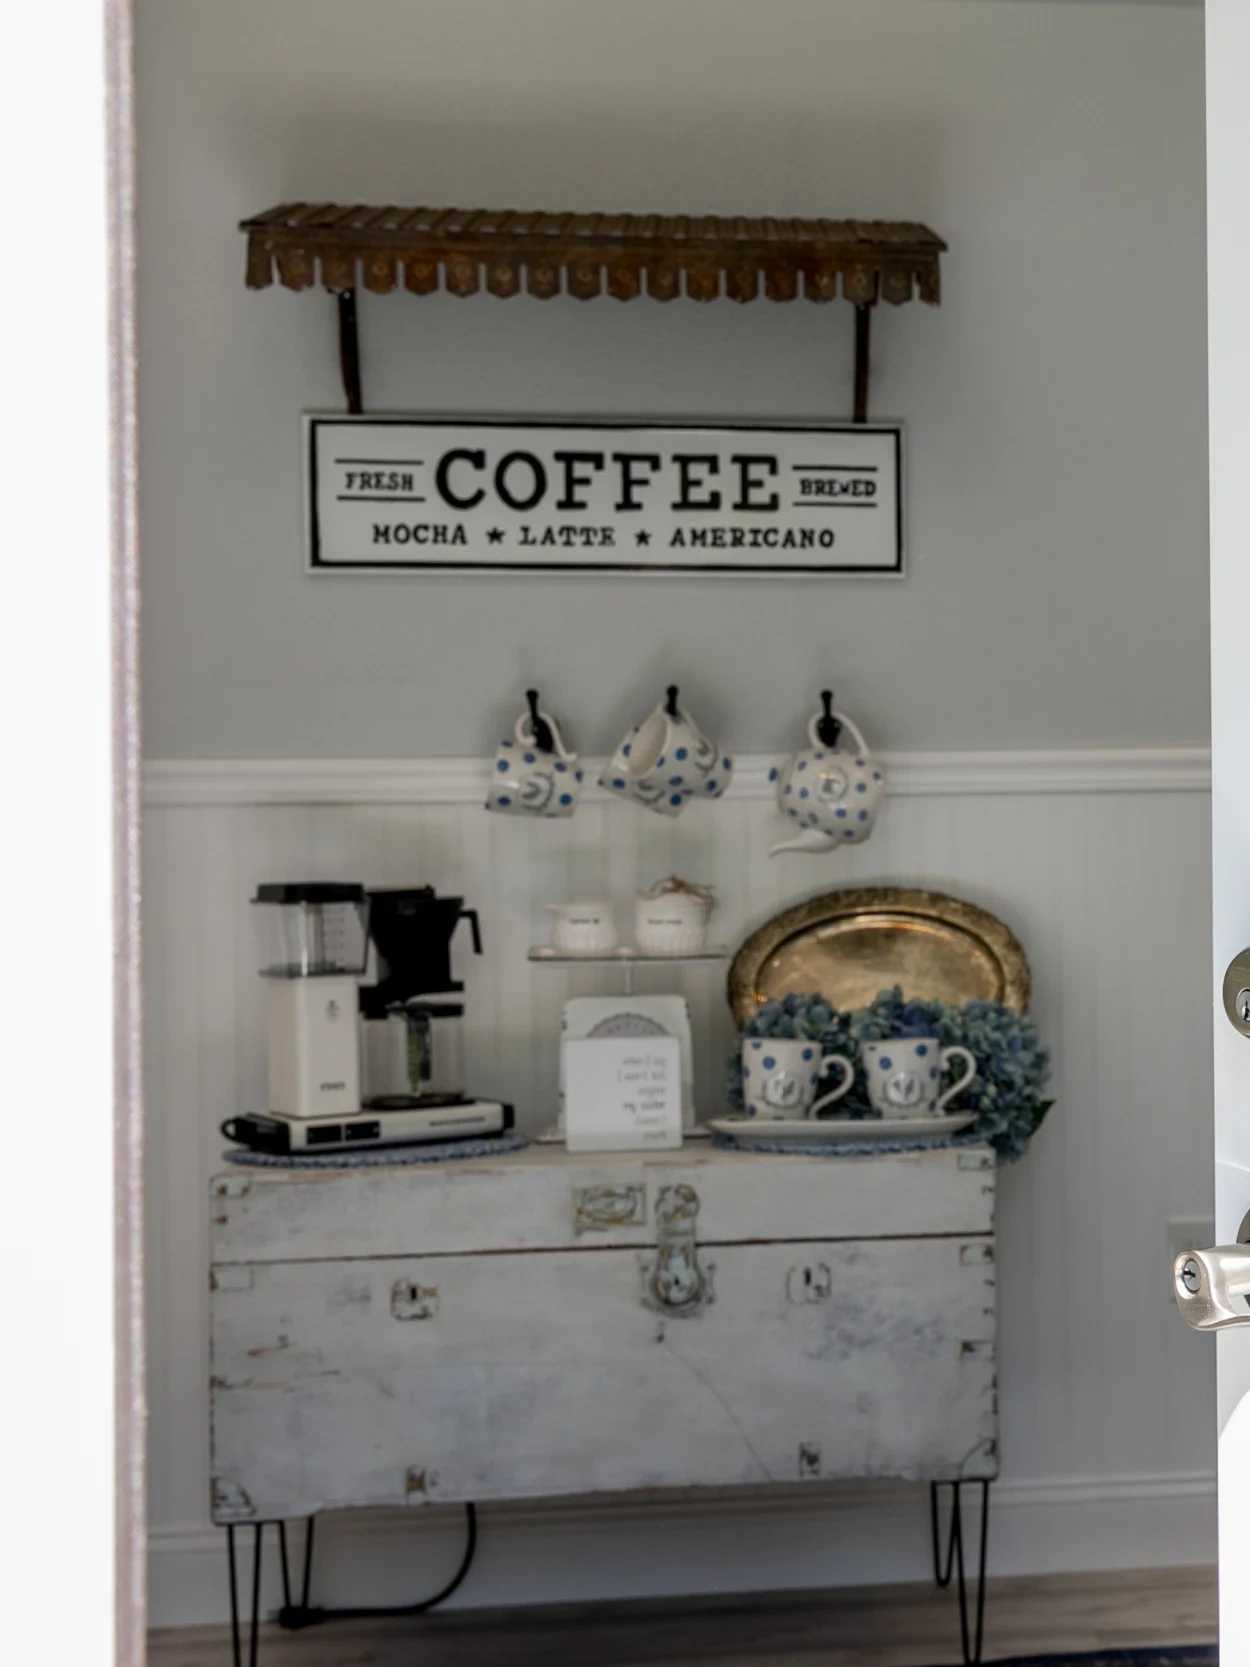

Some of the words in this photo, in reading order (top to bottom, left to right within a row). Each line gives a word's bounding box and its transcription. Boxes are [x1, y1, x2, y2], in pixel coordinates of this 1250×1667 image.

[344, 471, 415, 492] FRESH
[433, 446, 782, 514] COFFEE
[798, 477, 878, 498] BREWED
[371, 523, 469, 547] MOCHA
[517, 524, 617, 548] LATTE
[668, 526, 836, 550] AMERICANO
